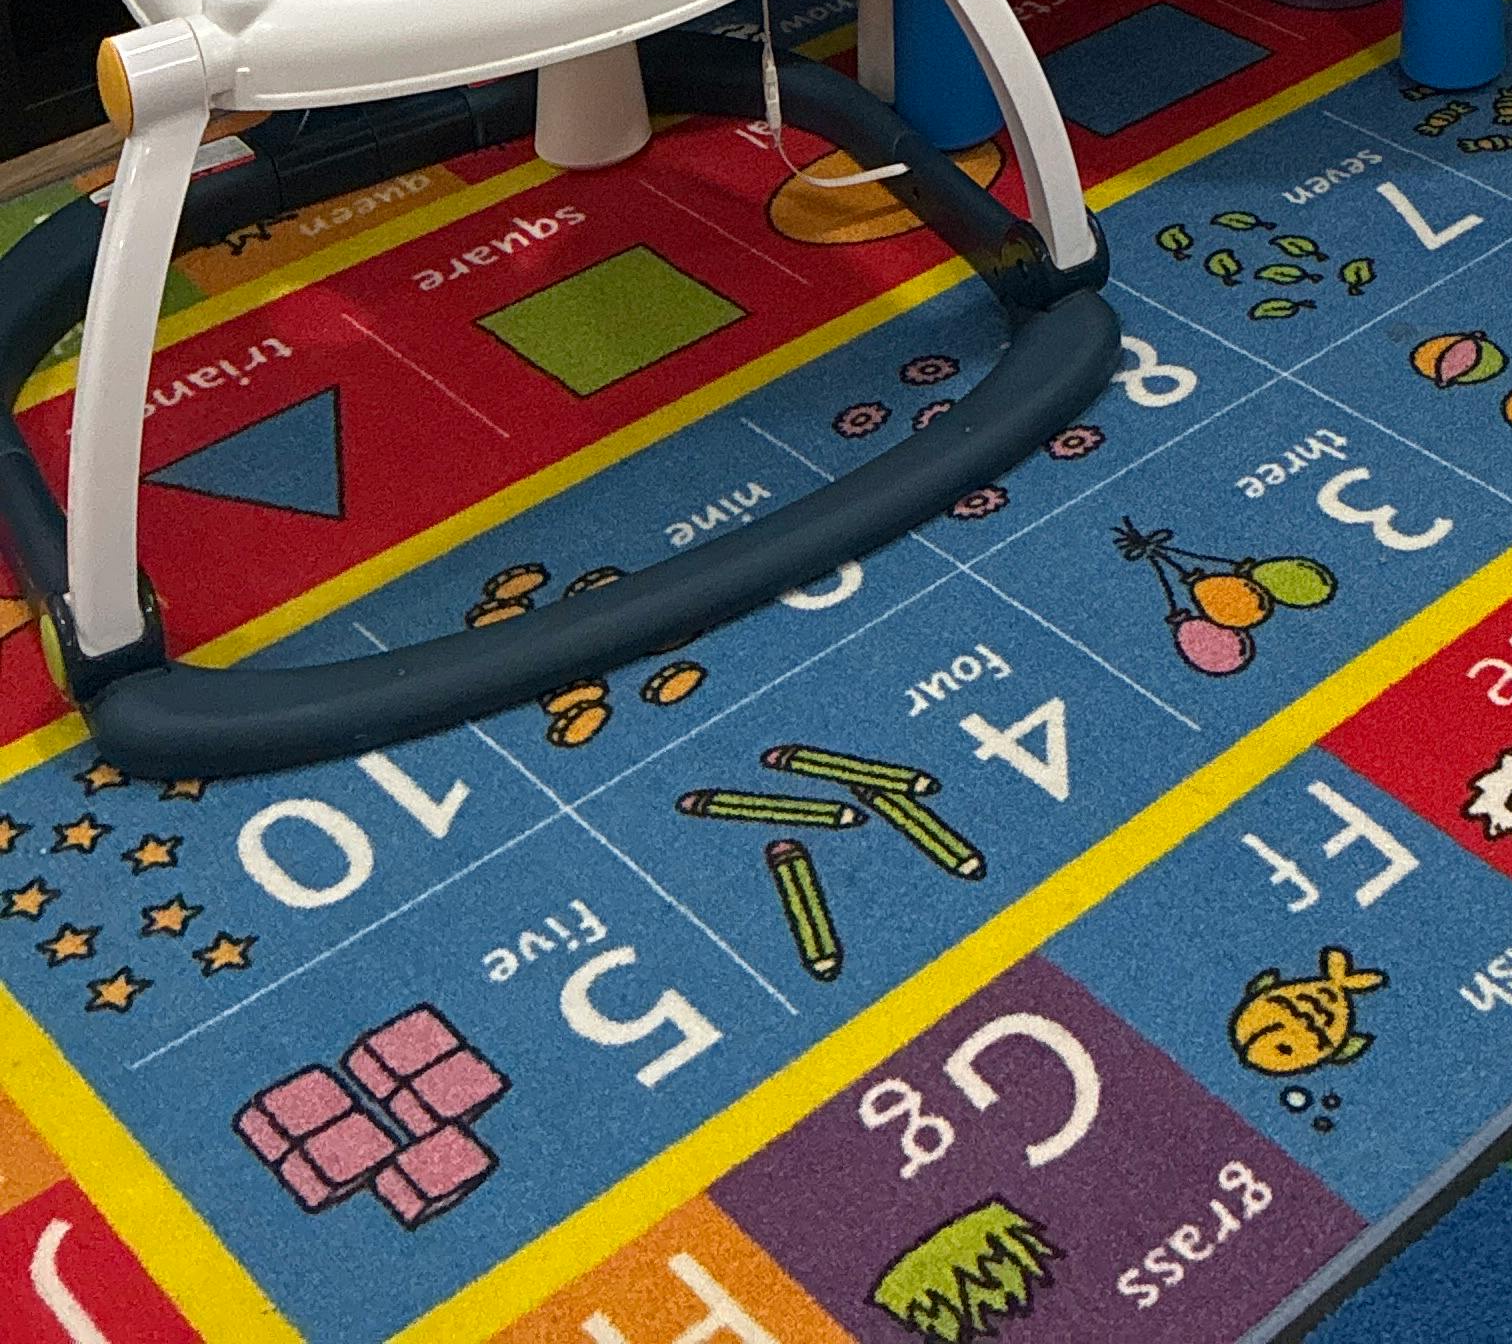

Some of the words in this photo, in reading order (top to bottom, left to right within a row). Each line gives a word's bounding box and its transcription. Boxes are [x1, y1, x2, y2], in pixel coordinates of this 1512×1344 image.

[300, 176, 429, 236] queen
[1282, 149, 1383, 206] seven
[1378, 183, 1482, 249] 7
[415, 208, 584, 290] square
[1234, 427, 1349, 500] three
[665, 481, 772, 548] nine
[1318, 468, 1452, 550] 3
[903, 642, 1013, 717] four
[960, 698, 1068, 801] 4
[238, 753, 469, 908] 10
[481, 899, 608, 984] five
[561, 947, 722, 1087] 5
[1118, 1162, 1272, 1307] grass
